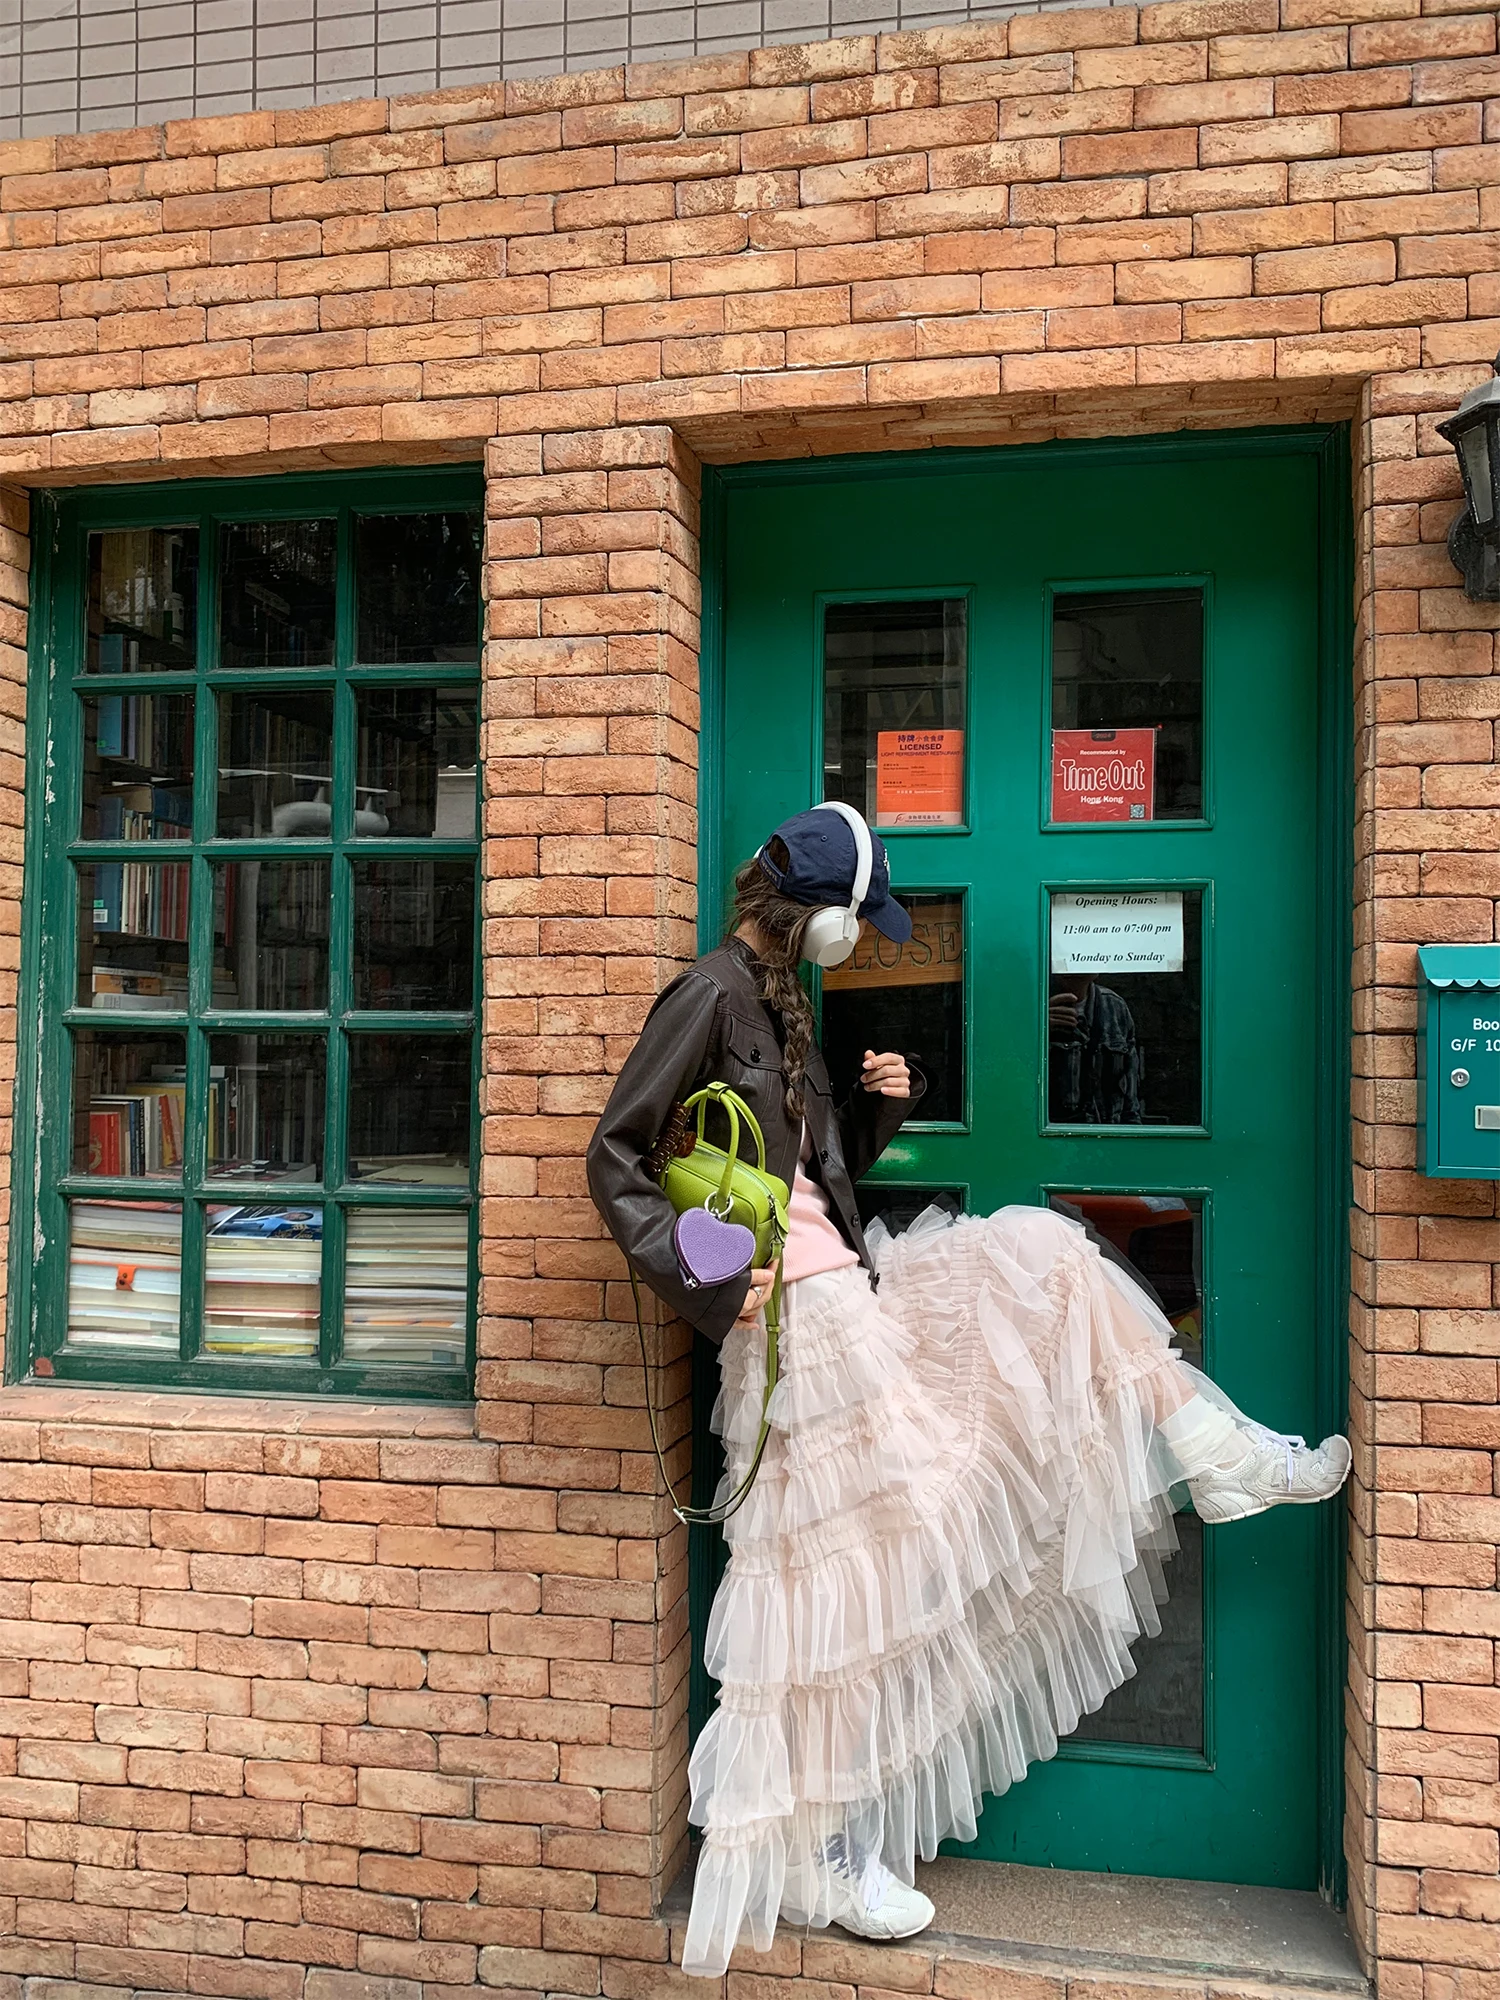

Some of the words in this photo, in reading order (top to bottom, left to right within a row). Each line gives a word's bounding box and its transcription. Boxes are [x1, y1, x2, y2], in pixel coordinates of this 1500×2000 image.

[1060, 758, 1107, 791] Time
[1109, 759, 1145, 791] Out
[1080, 795, 1102, 805] Hong
[1103, 795, 1124, 804] Kong
[1075, 896, 1118, 908] Opening
[1121, 895, 1158, 905] Hours:
[1063, 924, 1090, 934] 11:00
[1092, 925, 1108, 933] am
[1111, 924, 1121, 933] to
[1124, 923, 1153, 933] 07:00
[1154, 924, 1172, 935] pm
[823, 921, 962, 973] LOSE
[1070, 952, 1111, 964] Monday
[1113, 953, 1124, 962] to
[1126, 952, 1165, 963] Sunday
[1451, 1038, 1477, 1053] G/F
